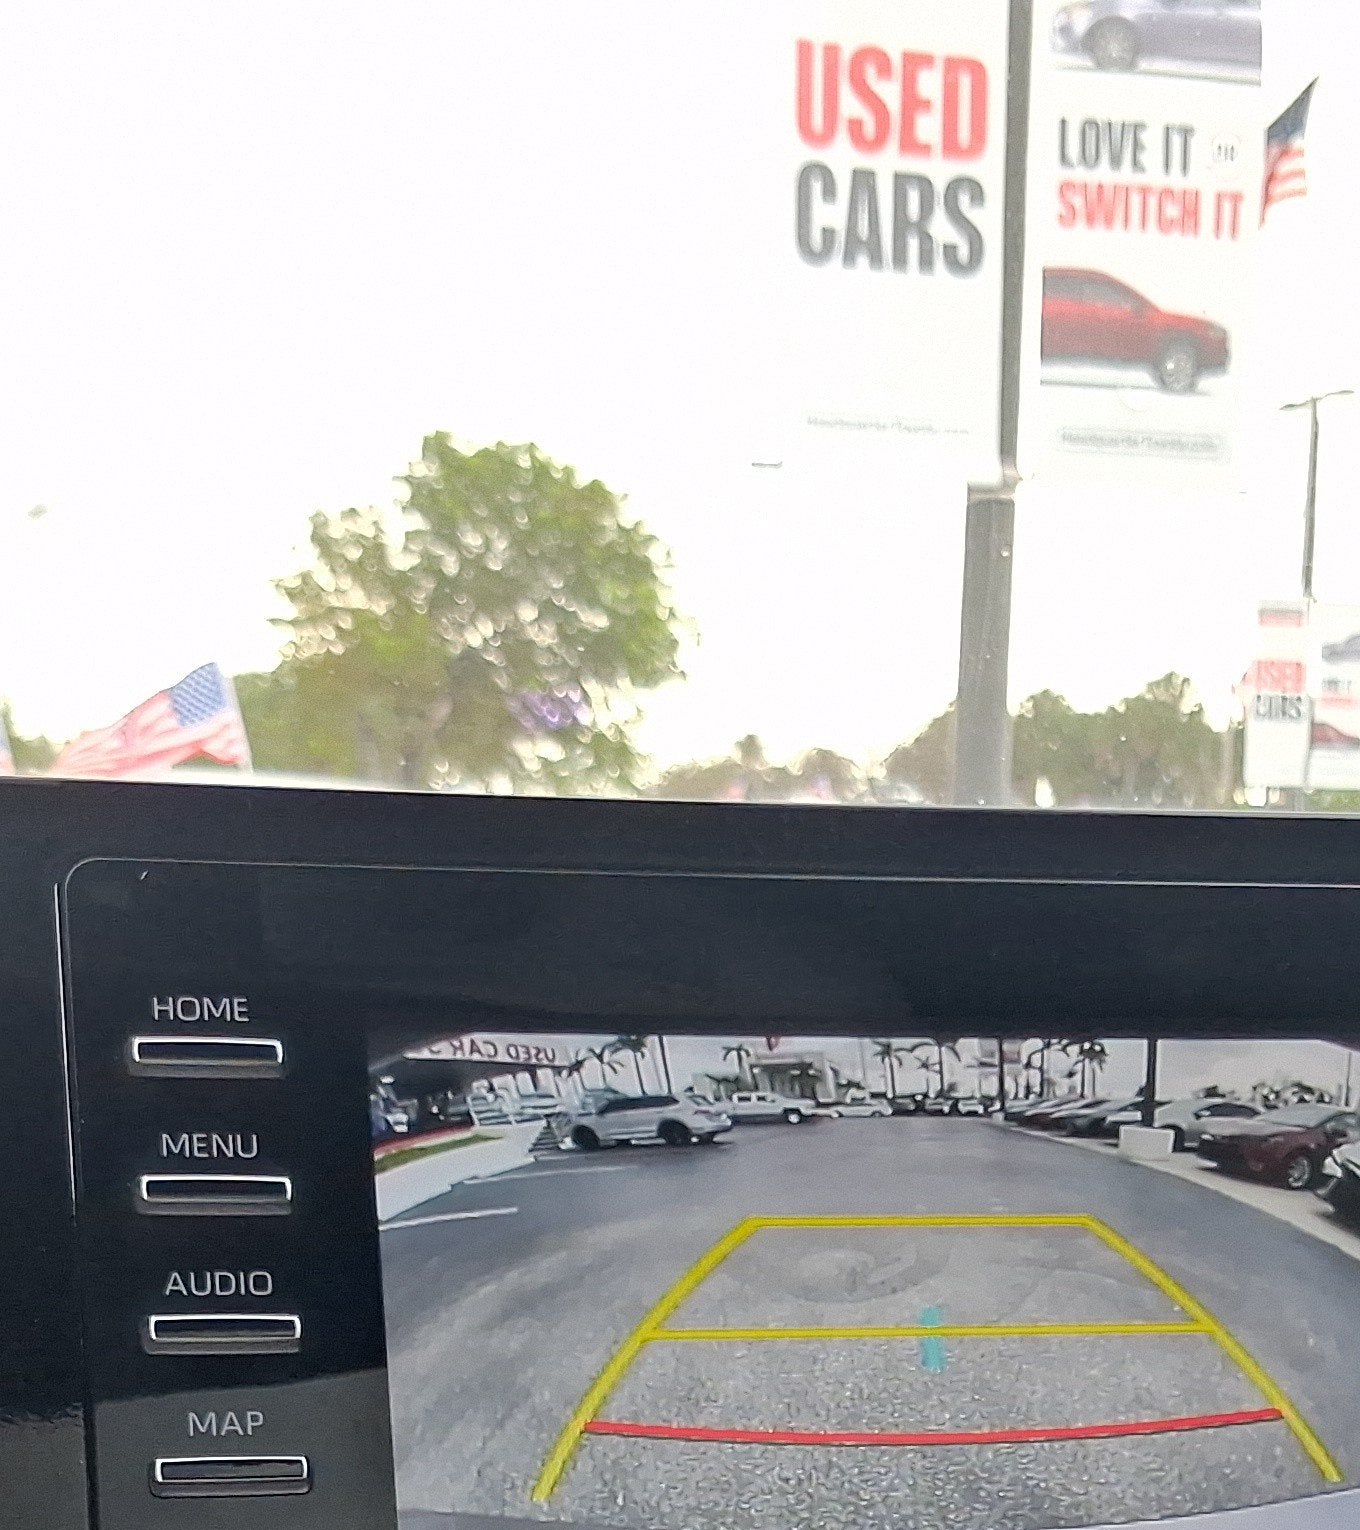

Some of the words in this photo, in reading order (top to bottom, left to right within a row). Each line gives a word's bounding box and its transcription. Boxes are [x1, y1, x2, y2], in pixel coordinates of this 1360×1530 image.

[796, 38, 989, 160] USED
[1059, 116, 1147, 174] LOVE
[1165, 123, 1196, 177] IT
[796, 160, 985, 278] CARS
[1057, 179, 1200, 239] SWITCH
[1210, 190, 1245, 241] IT
[152, 996, 250, 1022] HOME
[161, 1132, 258, 1159] MENU
[165, 1271, 274, 1296] AUDIO
[188, 1410, 264, 1437] MAP
